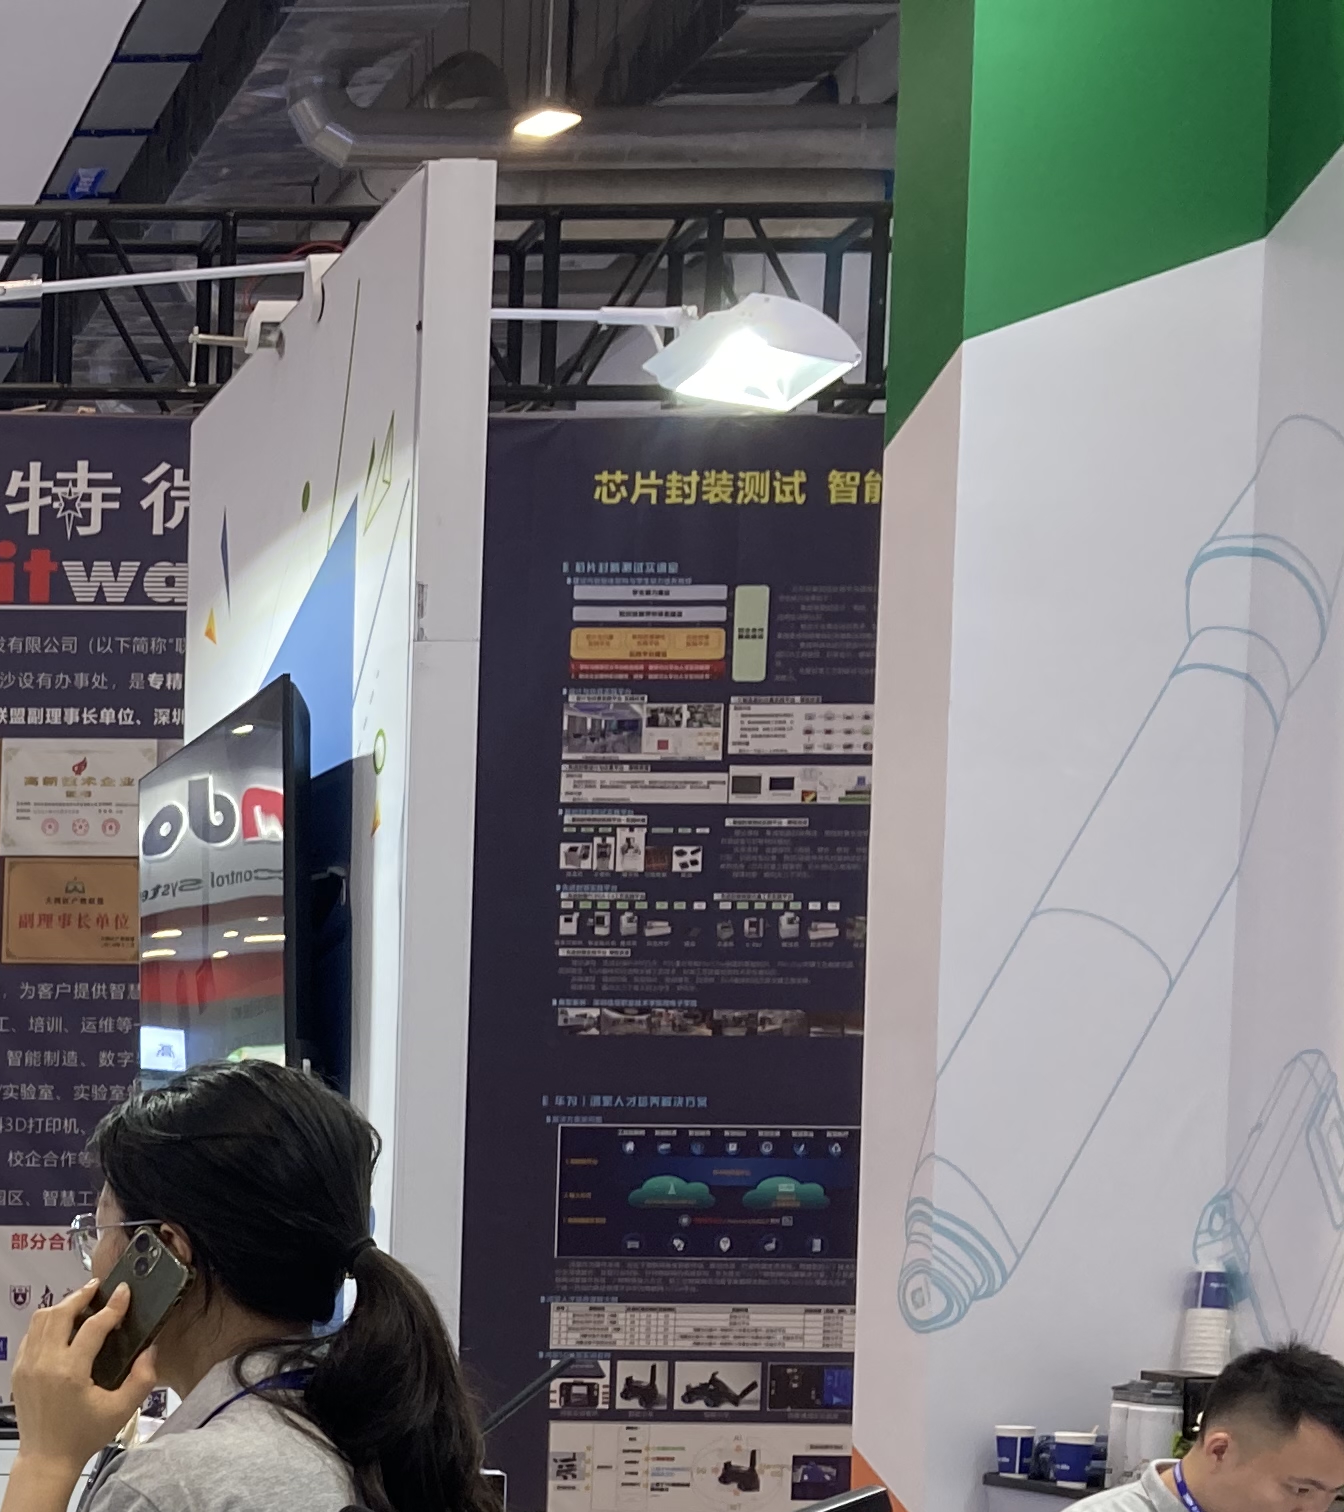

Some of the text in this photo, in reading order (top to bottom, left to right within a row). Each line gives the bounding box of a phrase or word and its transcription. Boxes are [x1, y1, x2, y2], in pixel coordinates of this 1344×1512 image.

[593, 470, 808, 505] 芯片封装测试
[17, 911, 131, 931] 副理事长单位
